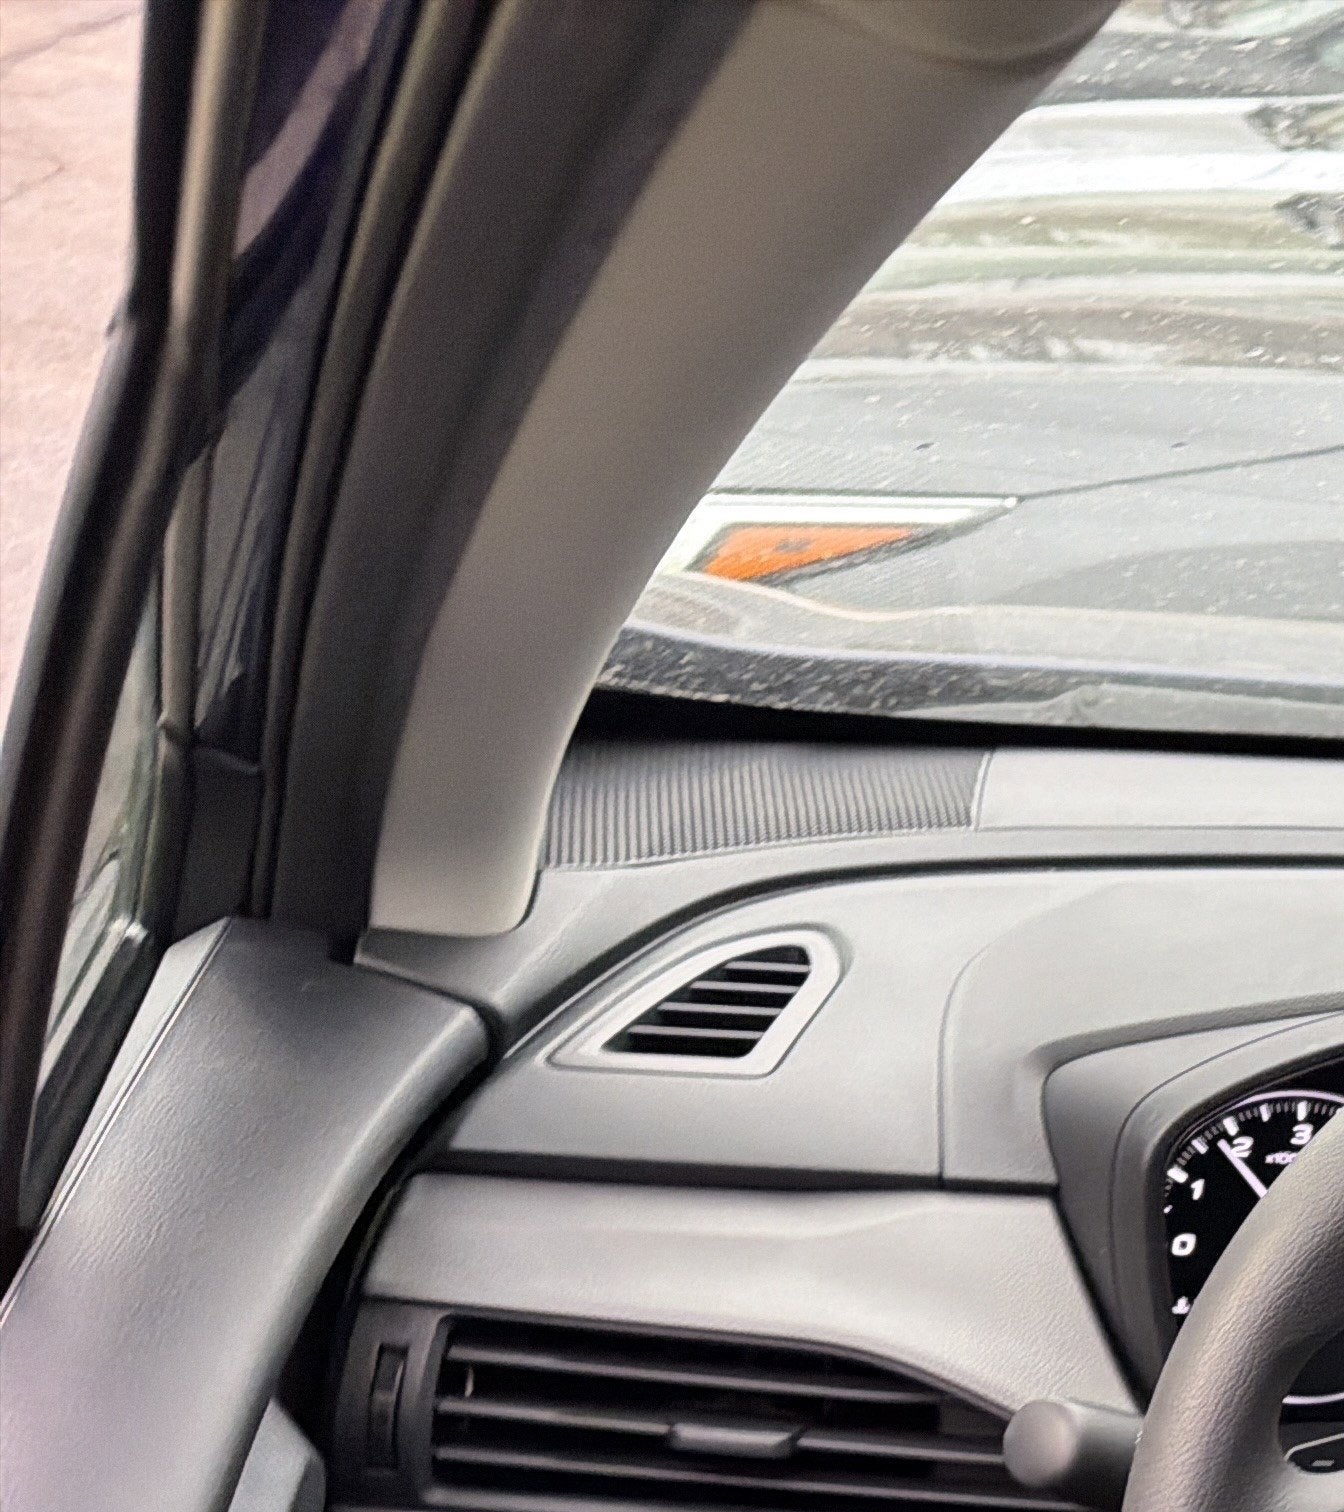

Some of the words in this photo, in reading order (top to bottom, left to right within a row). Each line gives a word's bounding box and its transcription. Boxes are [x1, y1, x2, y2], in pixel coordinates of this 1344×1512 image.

[1290, 1123, 1313, 1146] 3
[1231, 1136, 1254, 1158] 2
[1190, 1178, 1205, 1201] 1
[1171, 1232, 1197, 1256] 0
